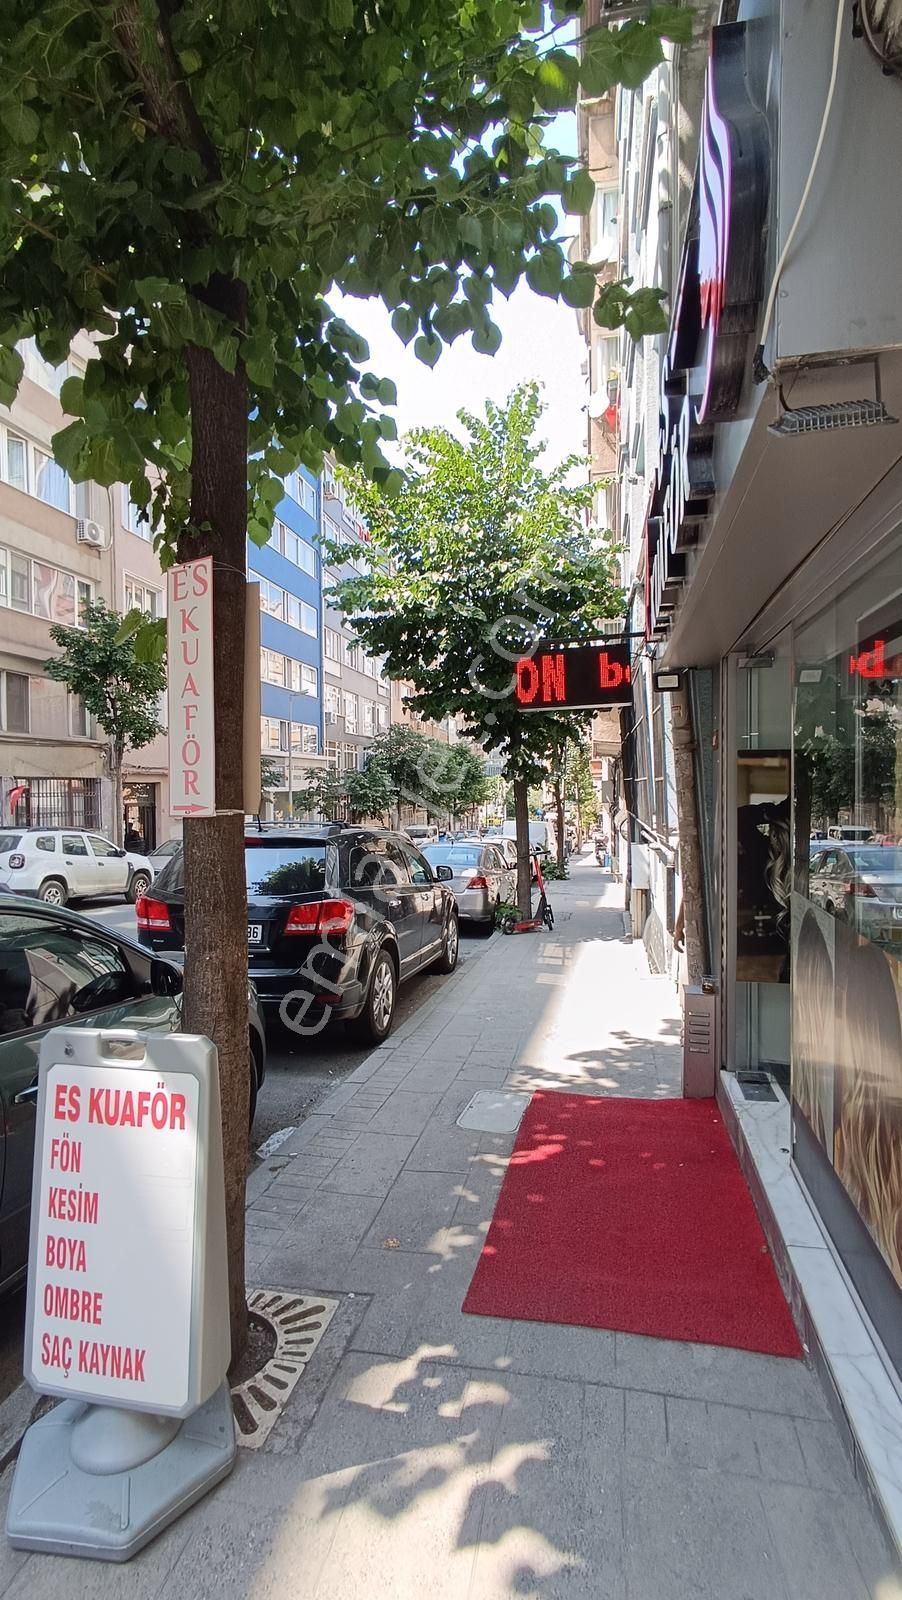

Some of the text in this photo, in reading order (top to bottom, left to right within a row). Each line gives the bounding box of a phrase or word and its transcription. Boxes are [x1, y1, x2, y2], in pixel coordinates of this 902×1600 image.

[171, 563, 209, 602] ES
[599, 652, 631, 688] b
[180, 606, 201, 795] KUAFÖR
[54, 1082, 186, 1130] ES KUAFÖR
[50, 1132, 82, 1173] FÖN
[48, 1183, 99, 1224] KESİM
[45, 1235, 87, 1272] BOYA
[43, 1283, 103, 1325] OMBRE
[41, 1332, 146, 1382] SAÇ KAYNAK
